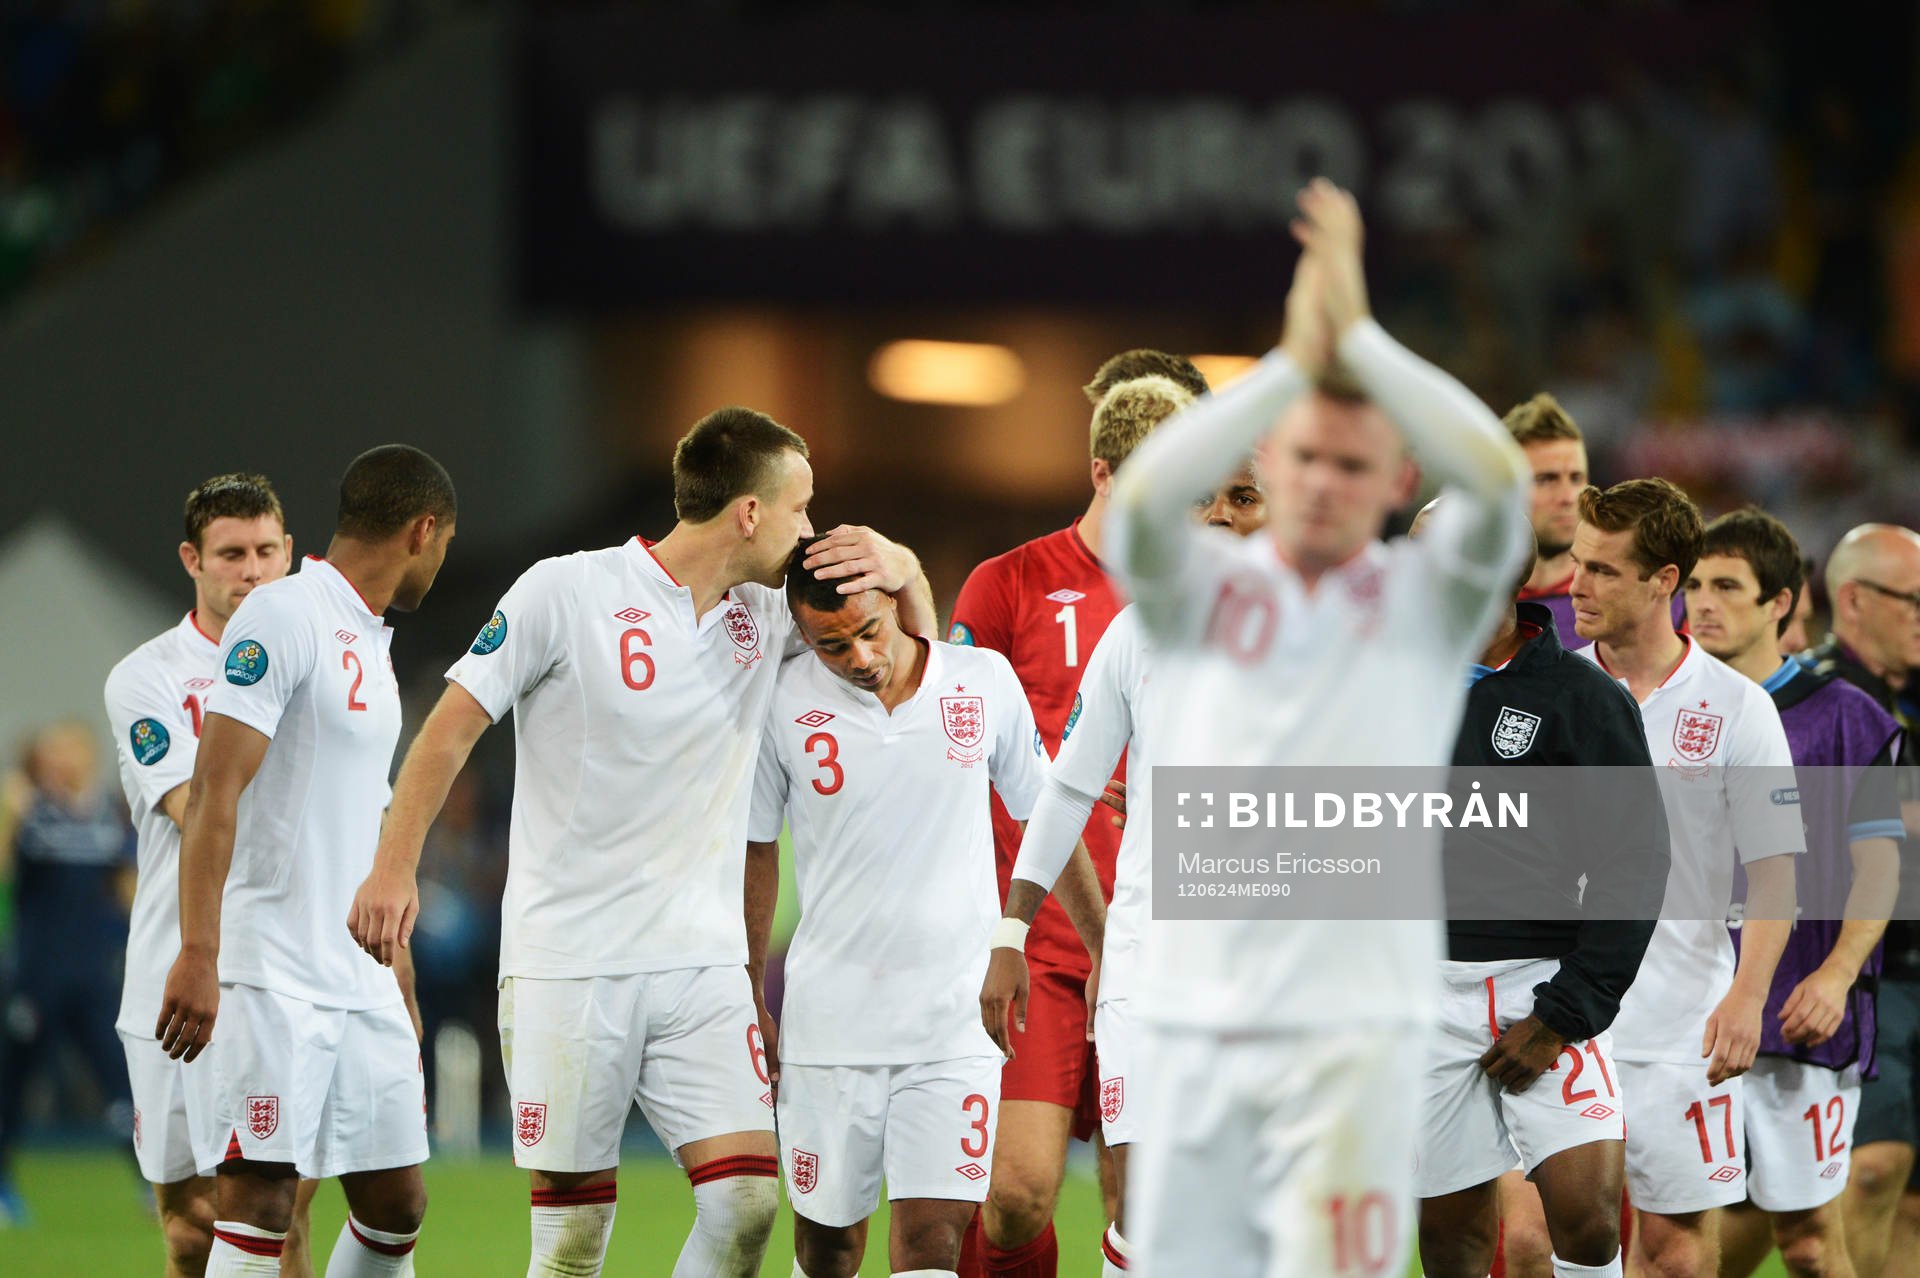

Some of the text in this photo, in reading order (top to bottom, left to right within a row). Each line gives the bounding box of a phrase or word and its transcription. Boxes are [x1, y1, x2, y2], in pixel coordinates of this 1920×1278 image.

[591, 95, 958, 229] UEFA
[968, 95, 1366, 229] EURO
[1055, 605, 1078, 667] 1
[1206, 572, 1280, 667] 10
[342, 650, 367, 711] 2
[619, 628, 656, 691] 6
[804, 732, 845, 796] 3
[746, 1023, 770, 1085] 6
[1551, 1039, 1615, 1105] 21
[961, 1094, 989, 1158] 3
[1684, 1094, 1736, 1163] 17
[1803, 1096, 1846, 1162] 12
[1324, 1192, 1396, 1273] 10
